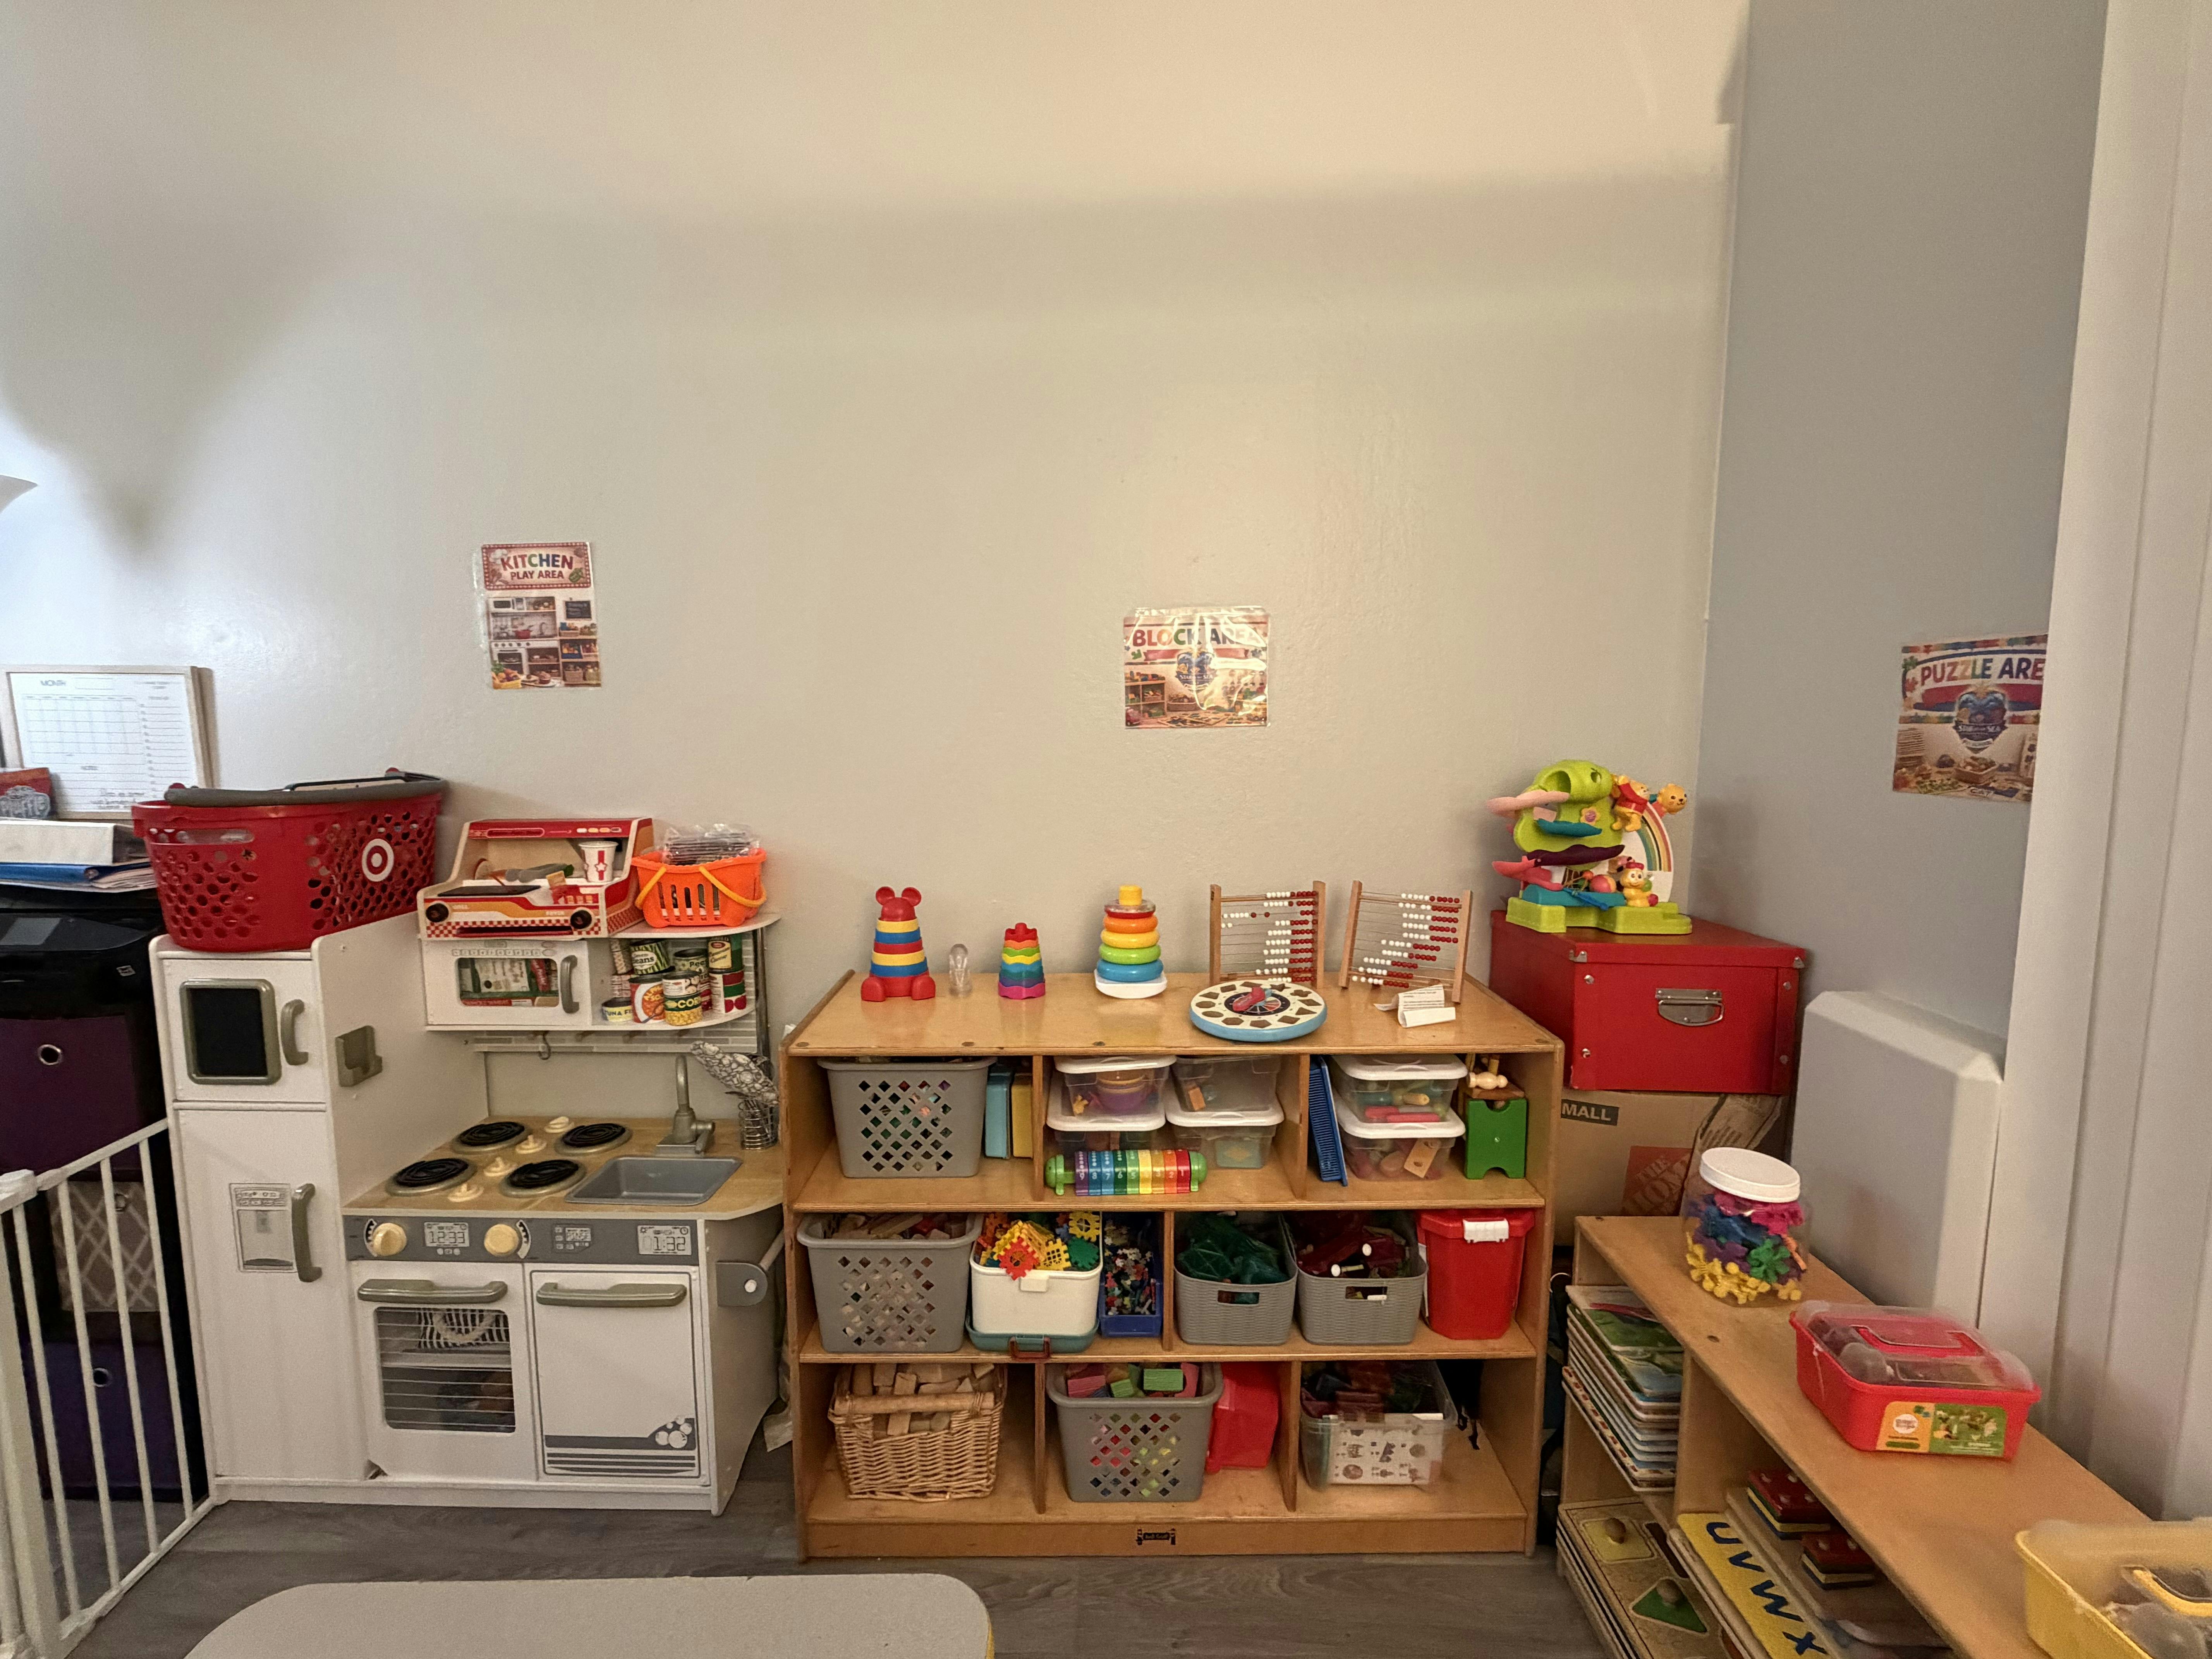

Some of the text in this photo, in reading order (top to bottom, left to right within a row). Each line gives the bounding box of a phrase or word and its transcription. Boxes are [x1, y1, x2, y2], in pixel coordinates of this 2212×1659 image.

[501, 553, 574, 571] KITCHEN
[510, 570, 564, 580] PLAY AREA
[1133, 629, 1202, 646] BLOCK
[1921, 658, 1993, 686] PUZZLE
[1561, 1103, 1611, 1121] MALL
[653, 1236, 685, 1251] 1:32
